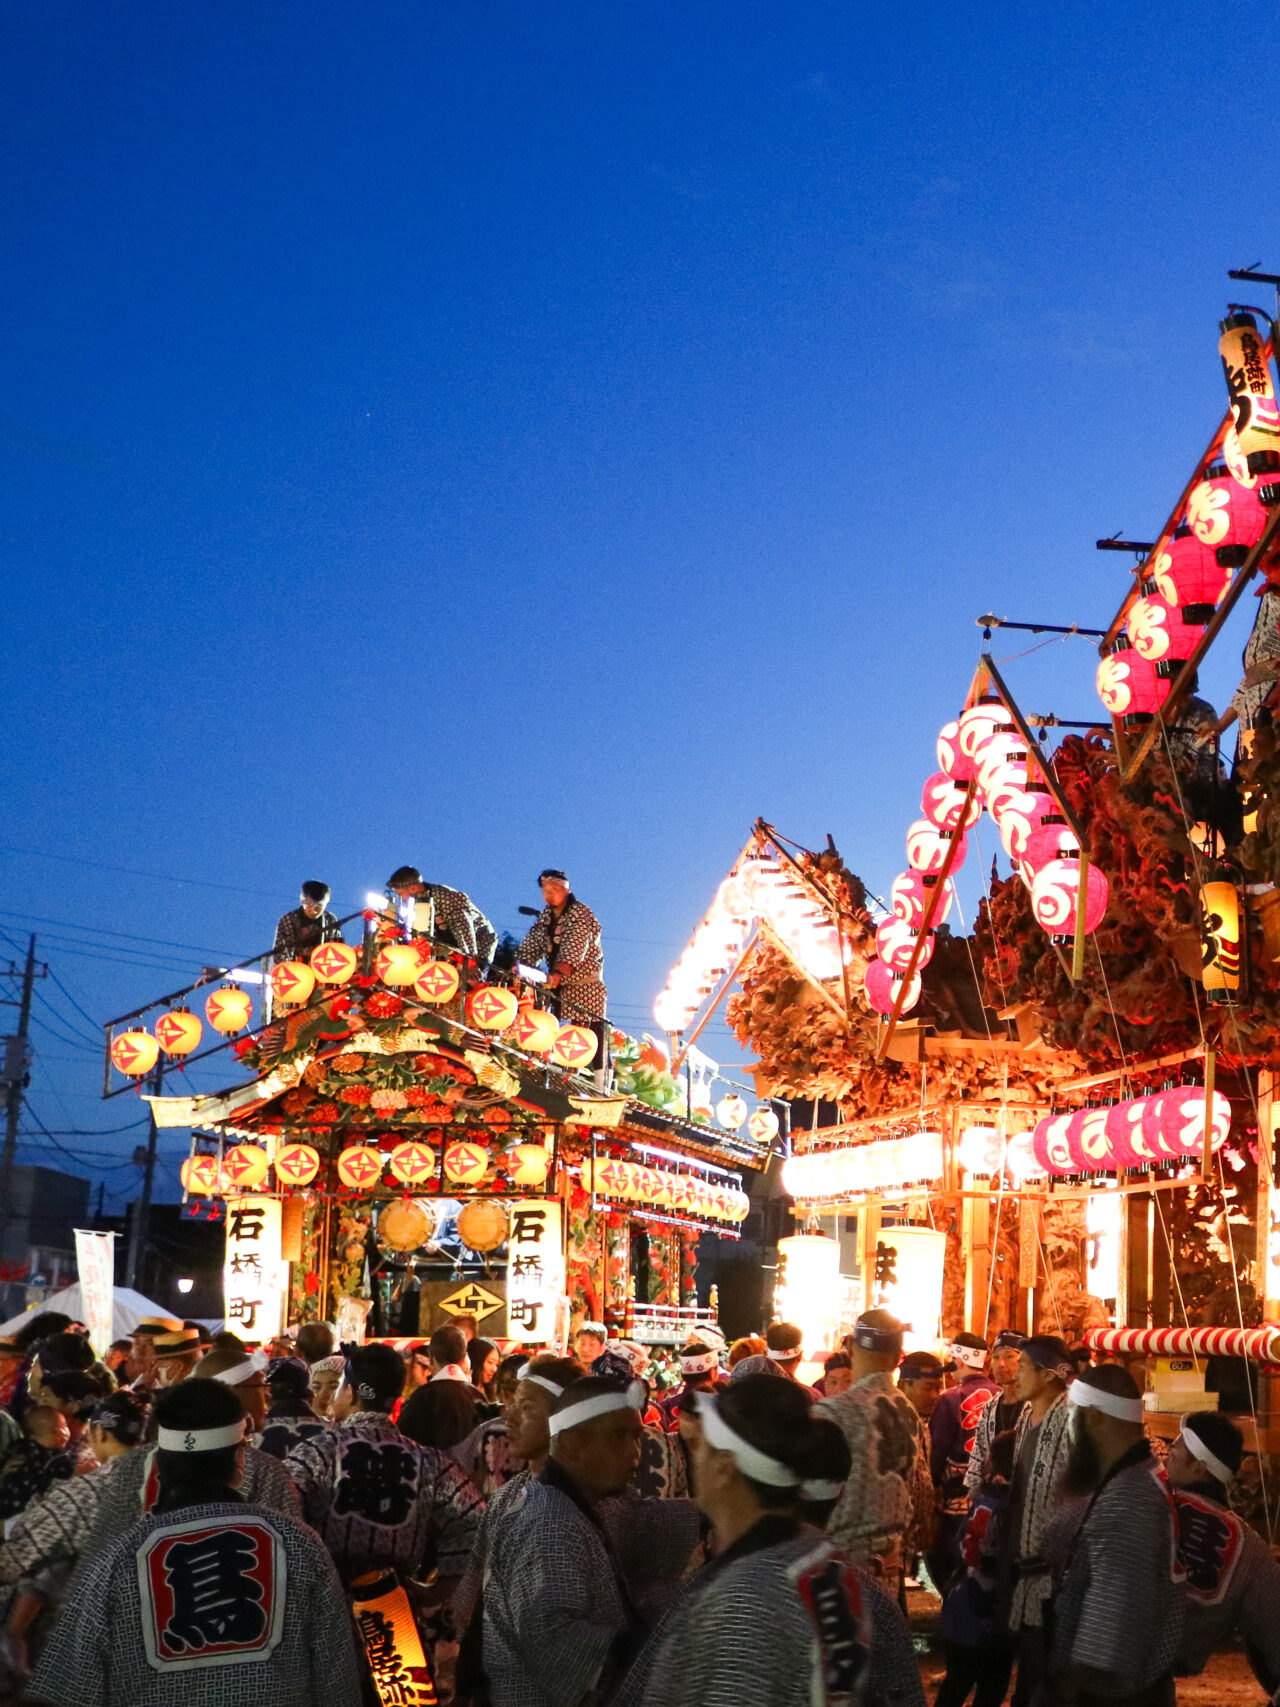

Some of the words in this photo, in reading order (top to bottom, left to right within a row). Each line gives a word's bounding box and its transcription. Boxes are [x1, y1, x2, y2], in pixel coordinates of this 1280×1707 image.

[228, 1208, 265, 1330] 石橋町
[510, 1207, 545, 1330] 石橋町
